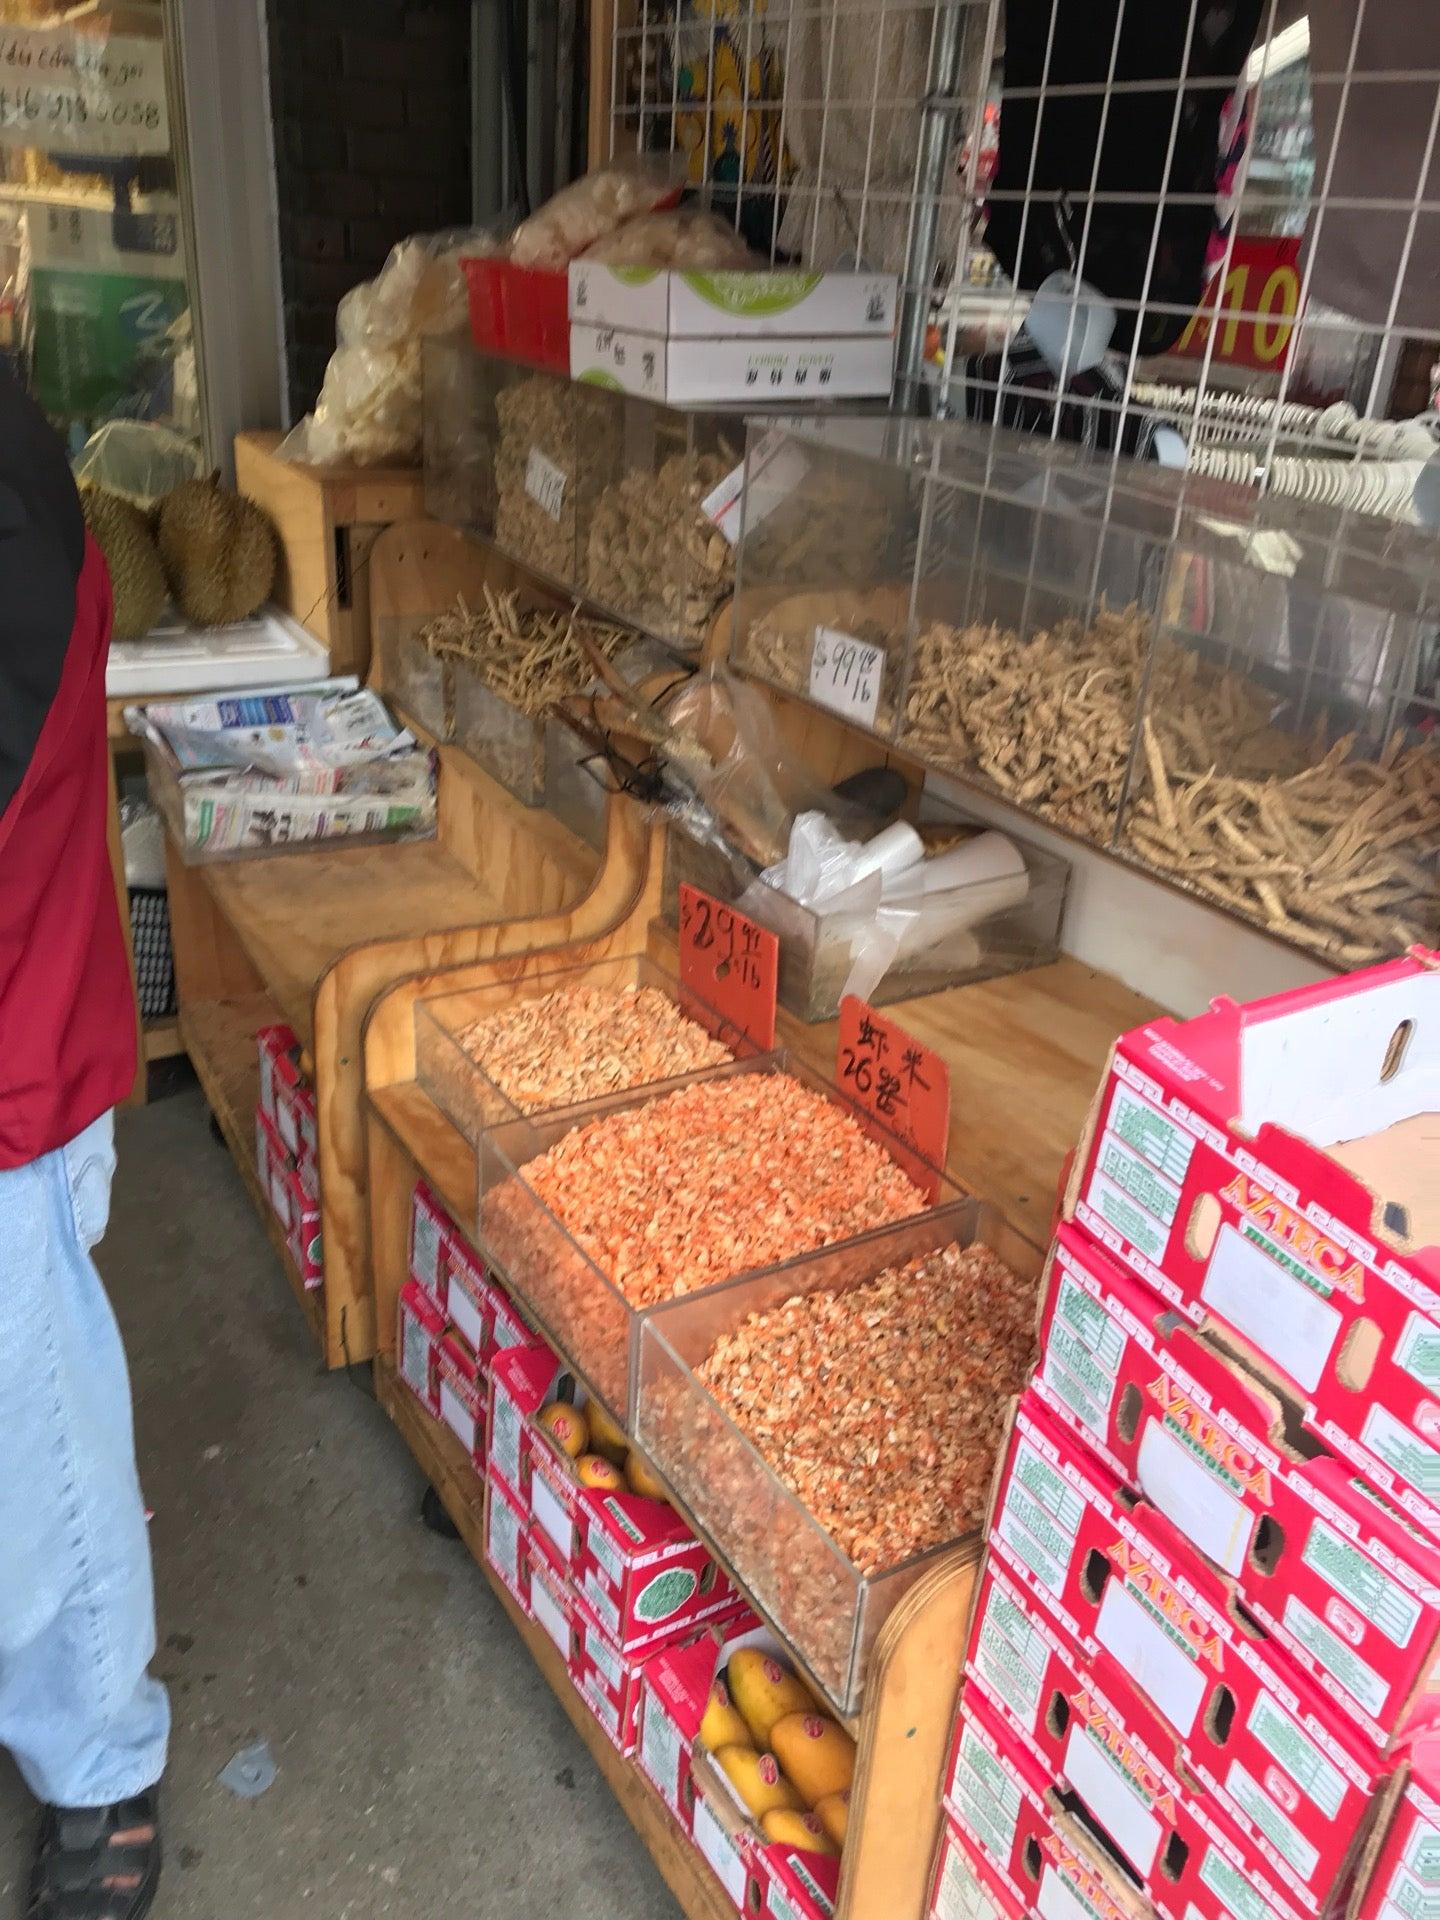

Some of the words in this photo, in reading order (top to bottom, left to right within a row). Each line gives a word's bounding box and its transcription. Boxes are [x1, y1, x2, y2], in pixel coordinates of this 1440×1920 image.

[1219, 1173, 1365, 1304] AZTECA
[1146, 1372, 1275, 1506] AZTECA
[1106, 1537, 1225, 1673] AZTECA
[1070, 1689, 1178, 1826] AZTECA
